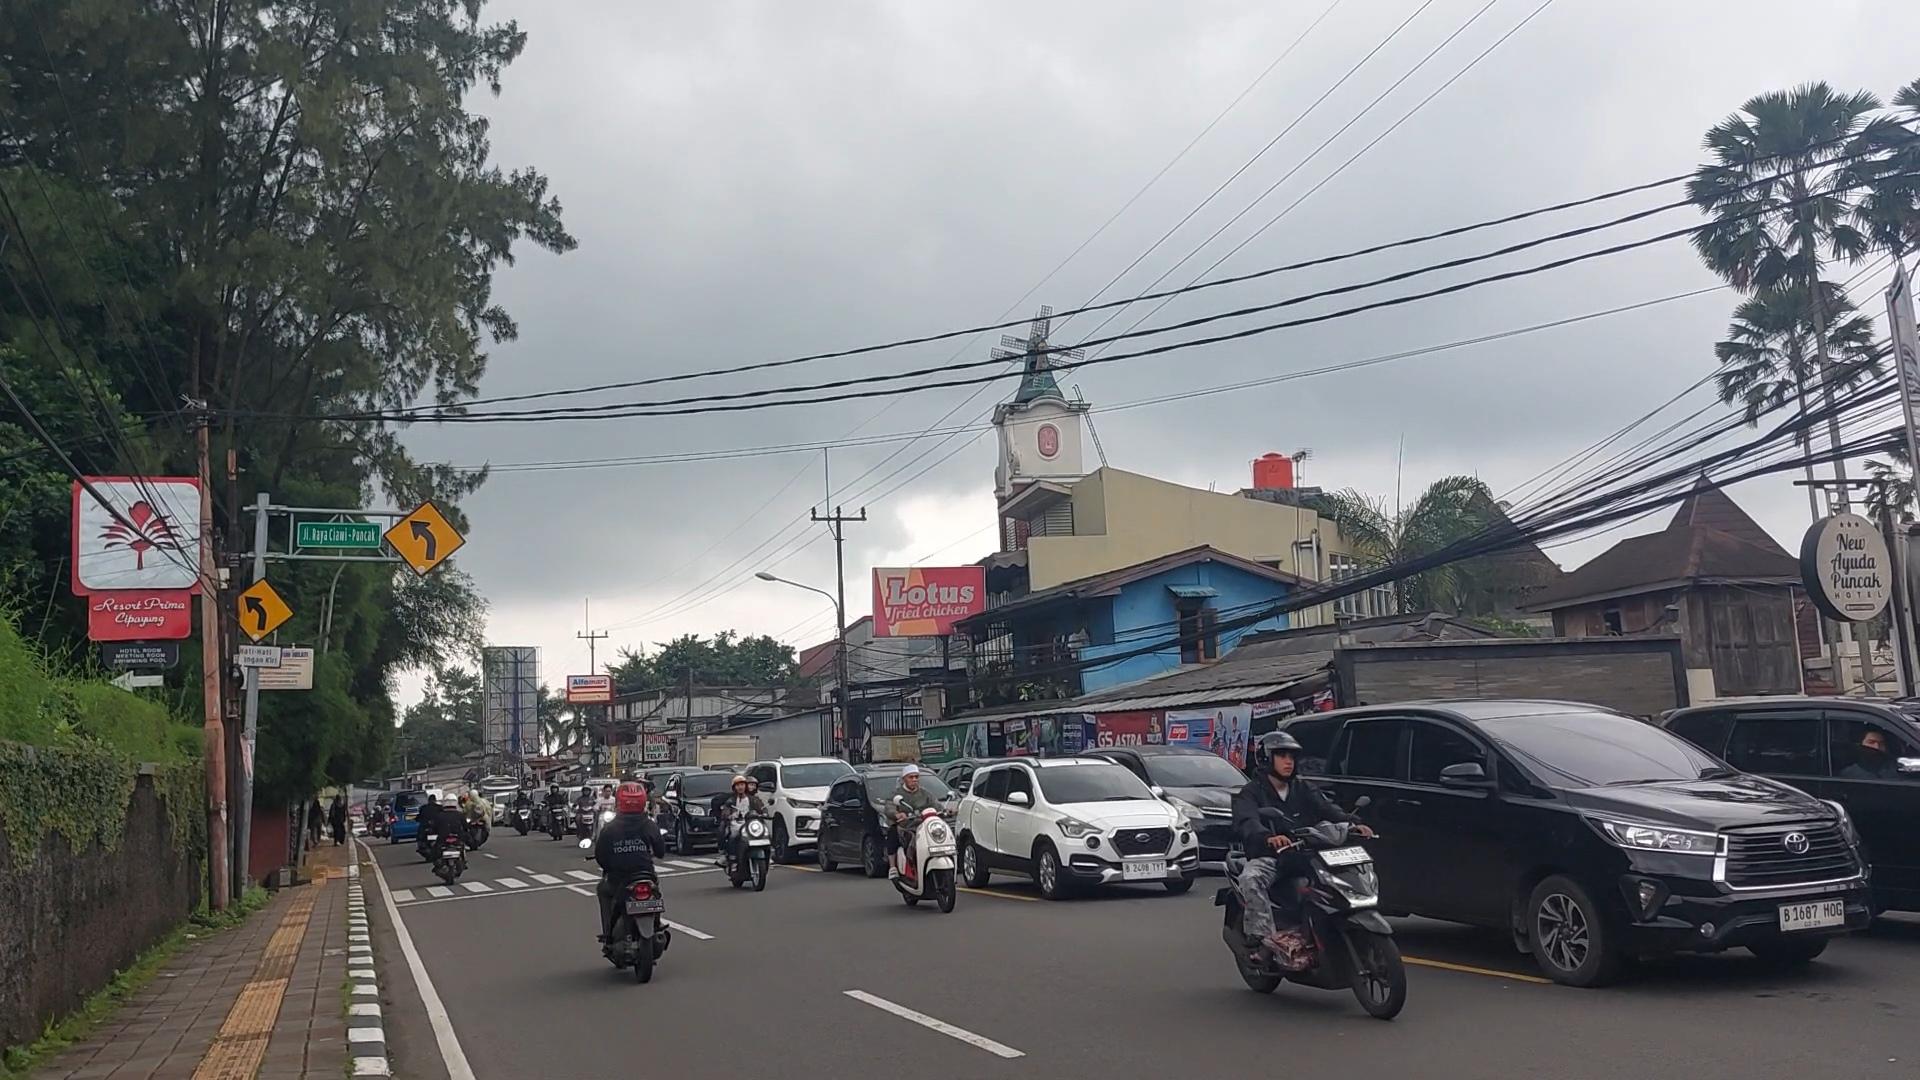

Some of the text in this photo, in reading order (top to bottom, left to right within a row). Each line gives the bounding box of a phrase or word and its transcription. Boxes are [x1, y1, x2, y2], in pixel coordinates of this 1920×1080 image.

[303, 527, 311, 541] Jl.
[312, 528, 328, 544] Raya
[1836, 533, 1866, 551] New
[1830, 552, 1877, 575] Ayuda
[1830, 571, 1882, 589] Puncak
[887, 578, 975, 605] Lotus
[93, 597, 185, 612] Resort Prima
[115, 612, 165, 627] Cipayung
[890, 604, 968, 624] fried chicken
[572, 678, 607, 686] Alfamart
[1098, 731, 1113, 748] GS
[1114, 733, 1142, 746] ASTRA
[1784, 902, 1842, 922] B 1687 HOG
